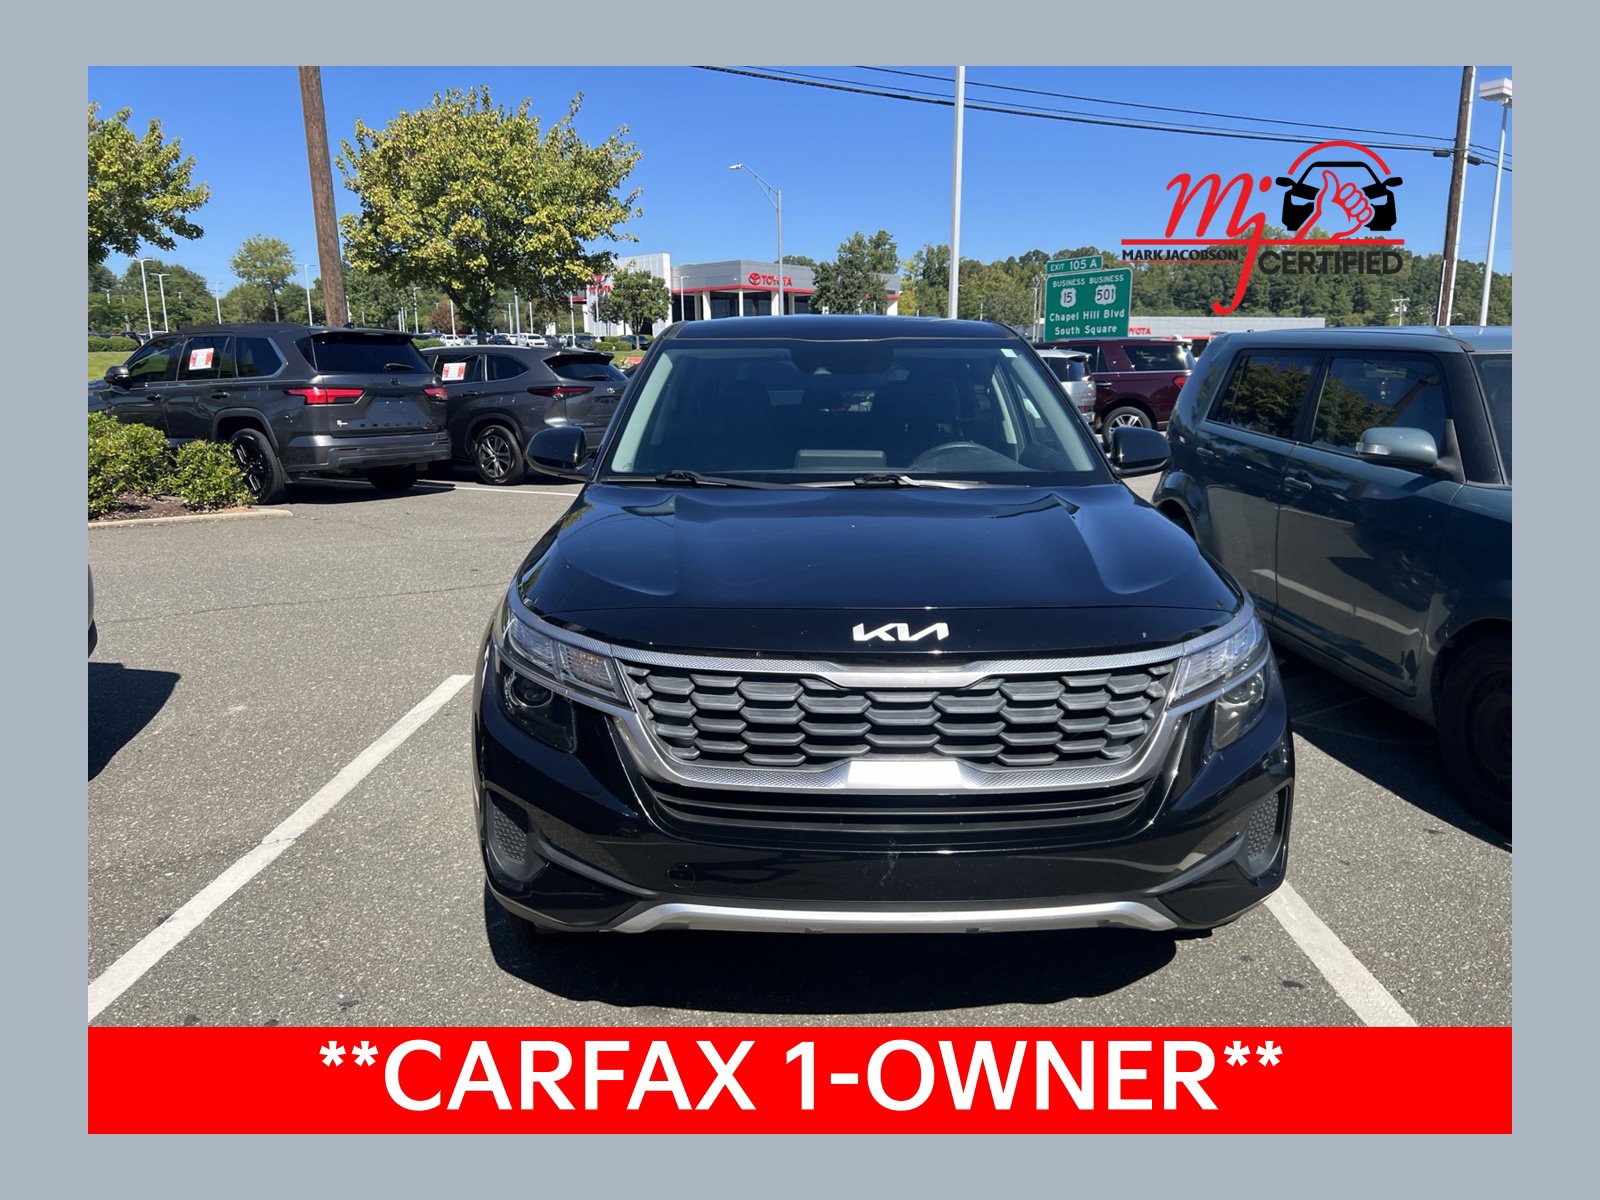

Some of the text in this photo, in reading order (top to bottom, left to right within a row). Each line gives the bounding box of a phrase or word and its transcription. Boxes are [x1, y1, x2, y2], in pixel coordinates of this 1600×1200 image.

[1069, 259, 1087, 270] 105
[1089, 258, 1098, 268] A
[761, 274, 793, 287] TOYTA
[1053, 275, 1124, 288] BUSINESS BUSINESS
[1063, 289, 1114, 304] 15 501
[1049, 309, 1125, 322] Chapel Hill Blvd
[1054, 325, 1117, 335] South Square
[852, 622, 950, 643] KIA
